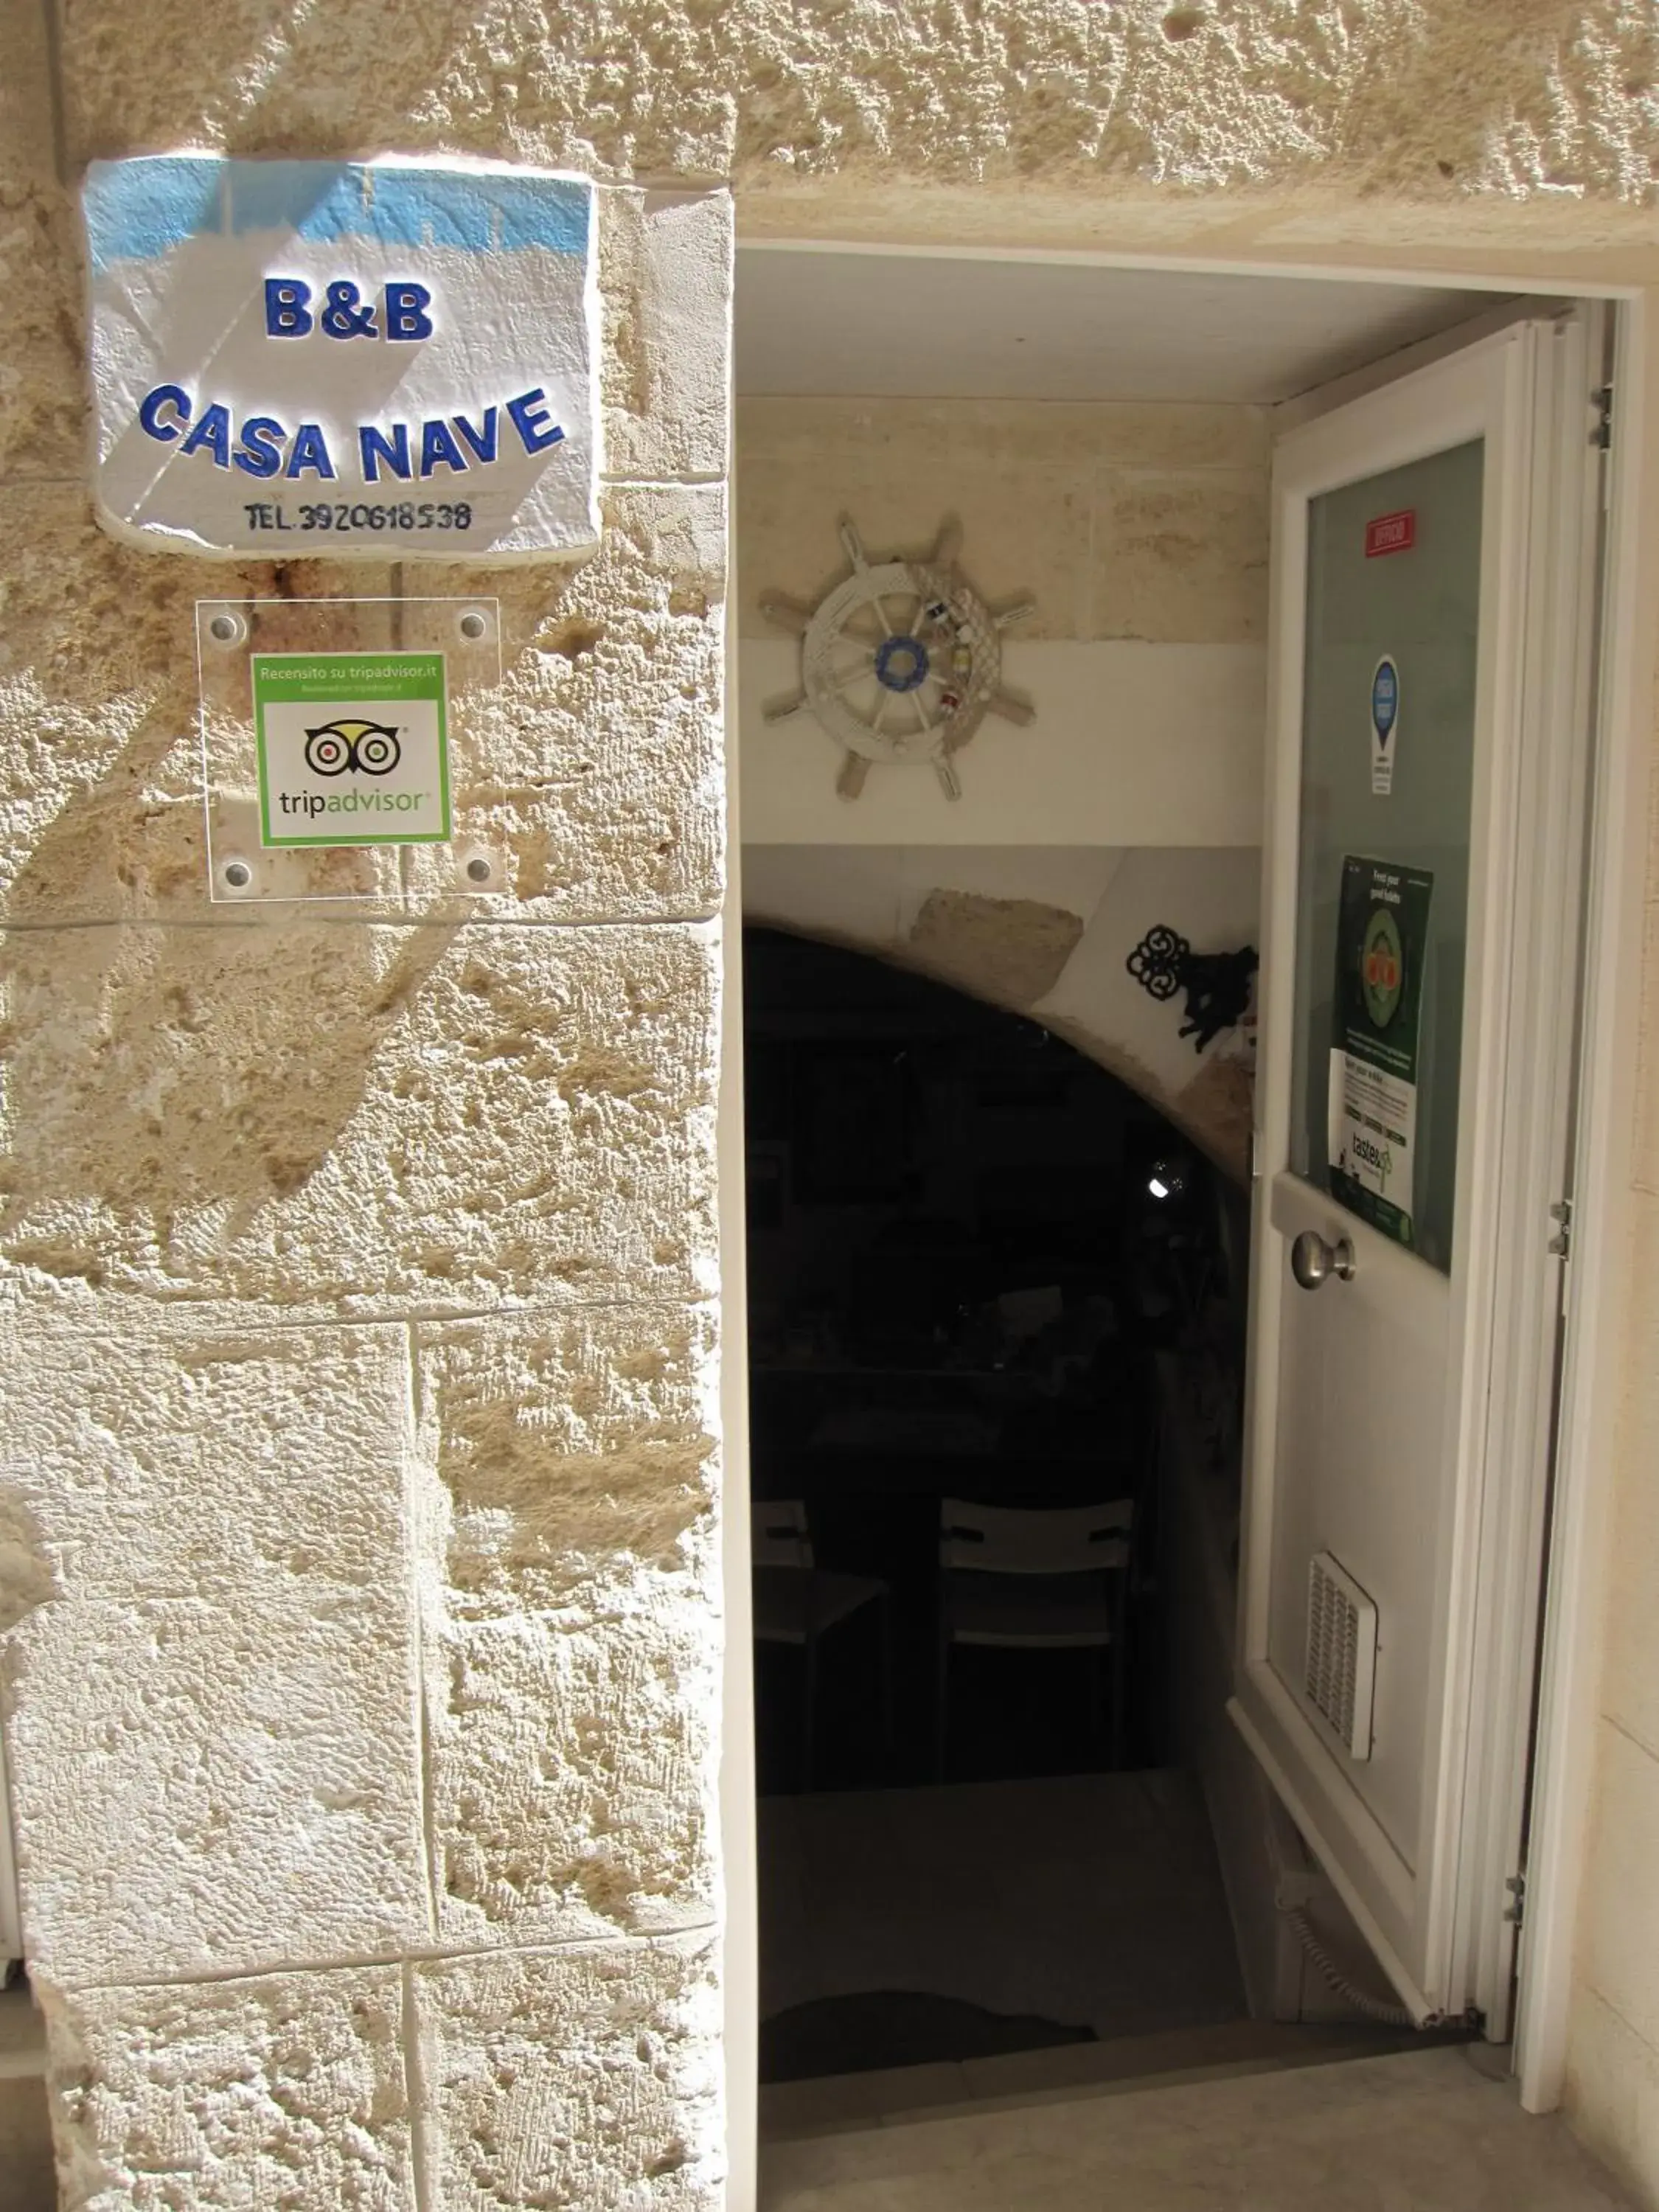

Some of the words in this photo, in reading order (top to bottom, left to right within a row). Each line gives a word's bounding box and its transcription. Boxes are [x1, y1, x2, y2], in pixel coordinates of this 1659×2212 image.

[264, 278, 434, 342] B&B
[139, 383, 335, 481] CASA
[358, 387, 566, 482] NAVE
[260, 667, 327, 680] Recensito
[330, 667, 346, 678] su
[349, 664, 437, 679] tripadvisor.it
[279, 788, 424, 818] tripadvisor
